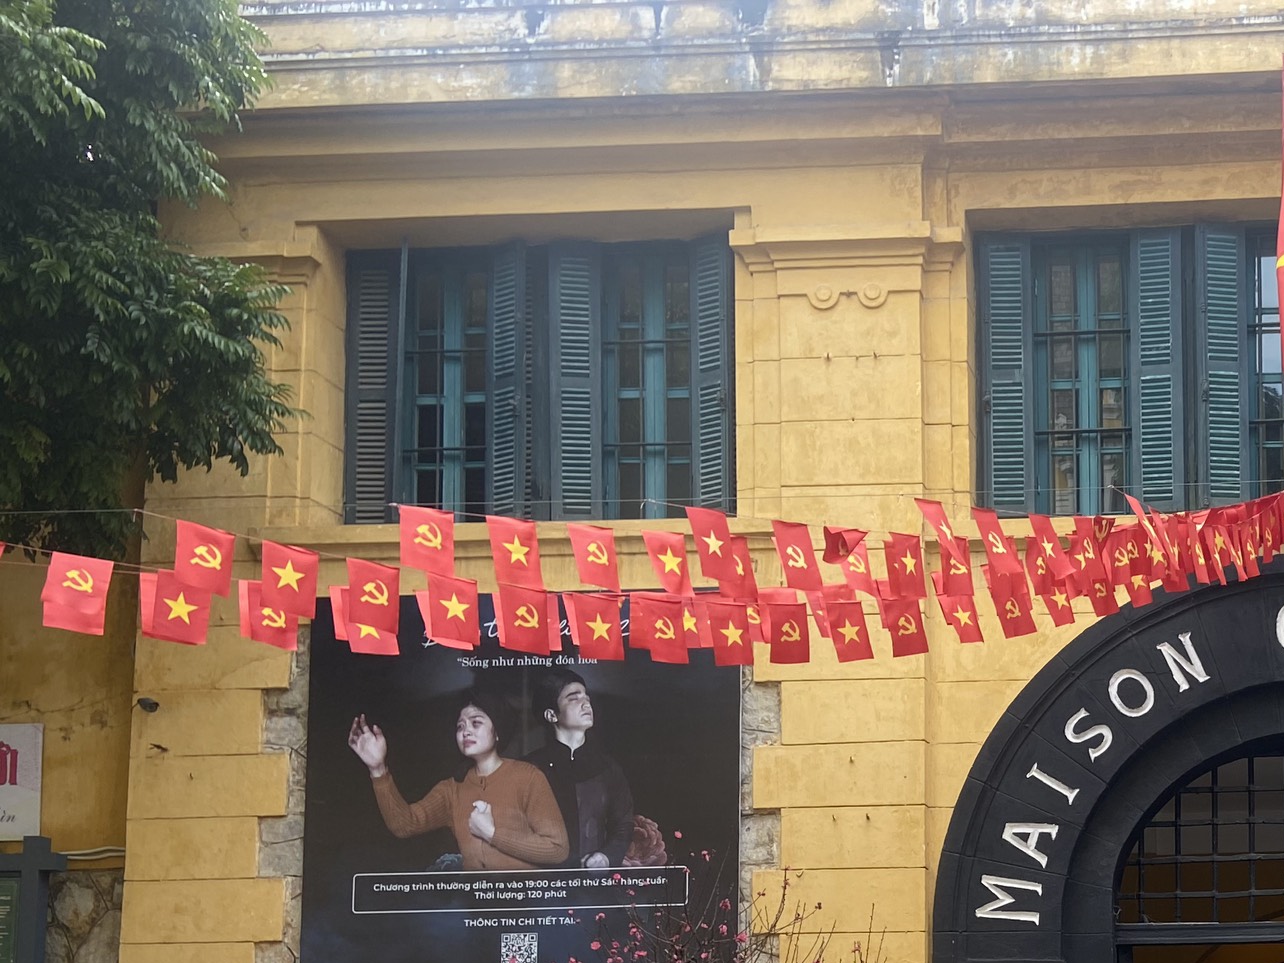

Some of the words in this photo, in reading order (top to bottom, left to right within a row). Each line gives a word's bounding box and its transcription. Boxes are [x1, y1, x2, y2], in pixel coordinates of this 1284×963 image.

[492, 656, 514, 667] như
[516, 655, 552, 668] những
[974, 630, 1212, 927] MAISON
[373, 882, 410, 893] Chương
[412, 881, 435, 891] trình
[436, 881, 470, 892] thường
[495, 881, 505, 889] ra
[507, 880, 523, 889] vào
[525, 880, 548, 888] 19:00
[550, 878, 567, 887] các
[583, 876, 599, 886] thứ
[474, 890, 494, 899] Thời
[496, 890, 526, 901] lượng:
[527, 890, 542, 898] 120
[544, 889, 567, 899] phút
[464, 917, 498, 927] THÔNG
[500, 917, 516, 926] TIN
[518, 917, 535, 926] CHI
[537, 915, 557, 925] TIẾT
